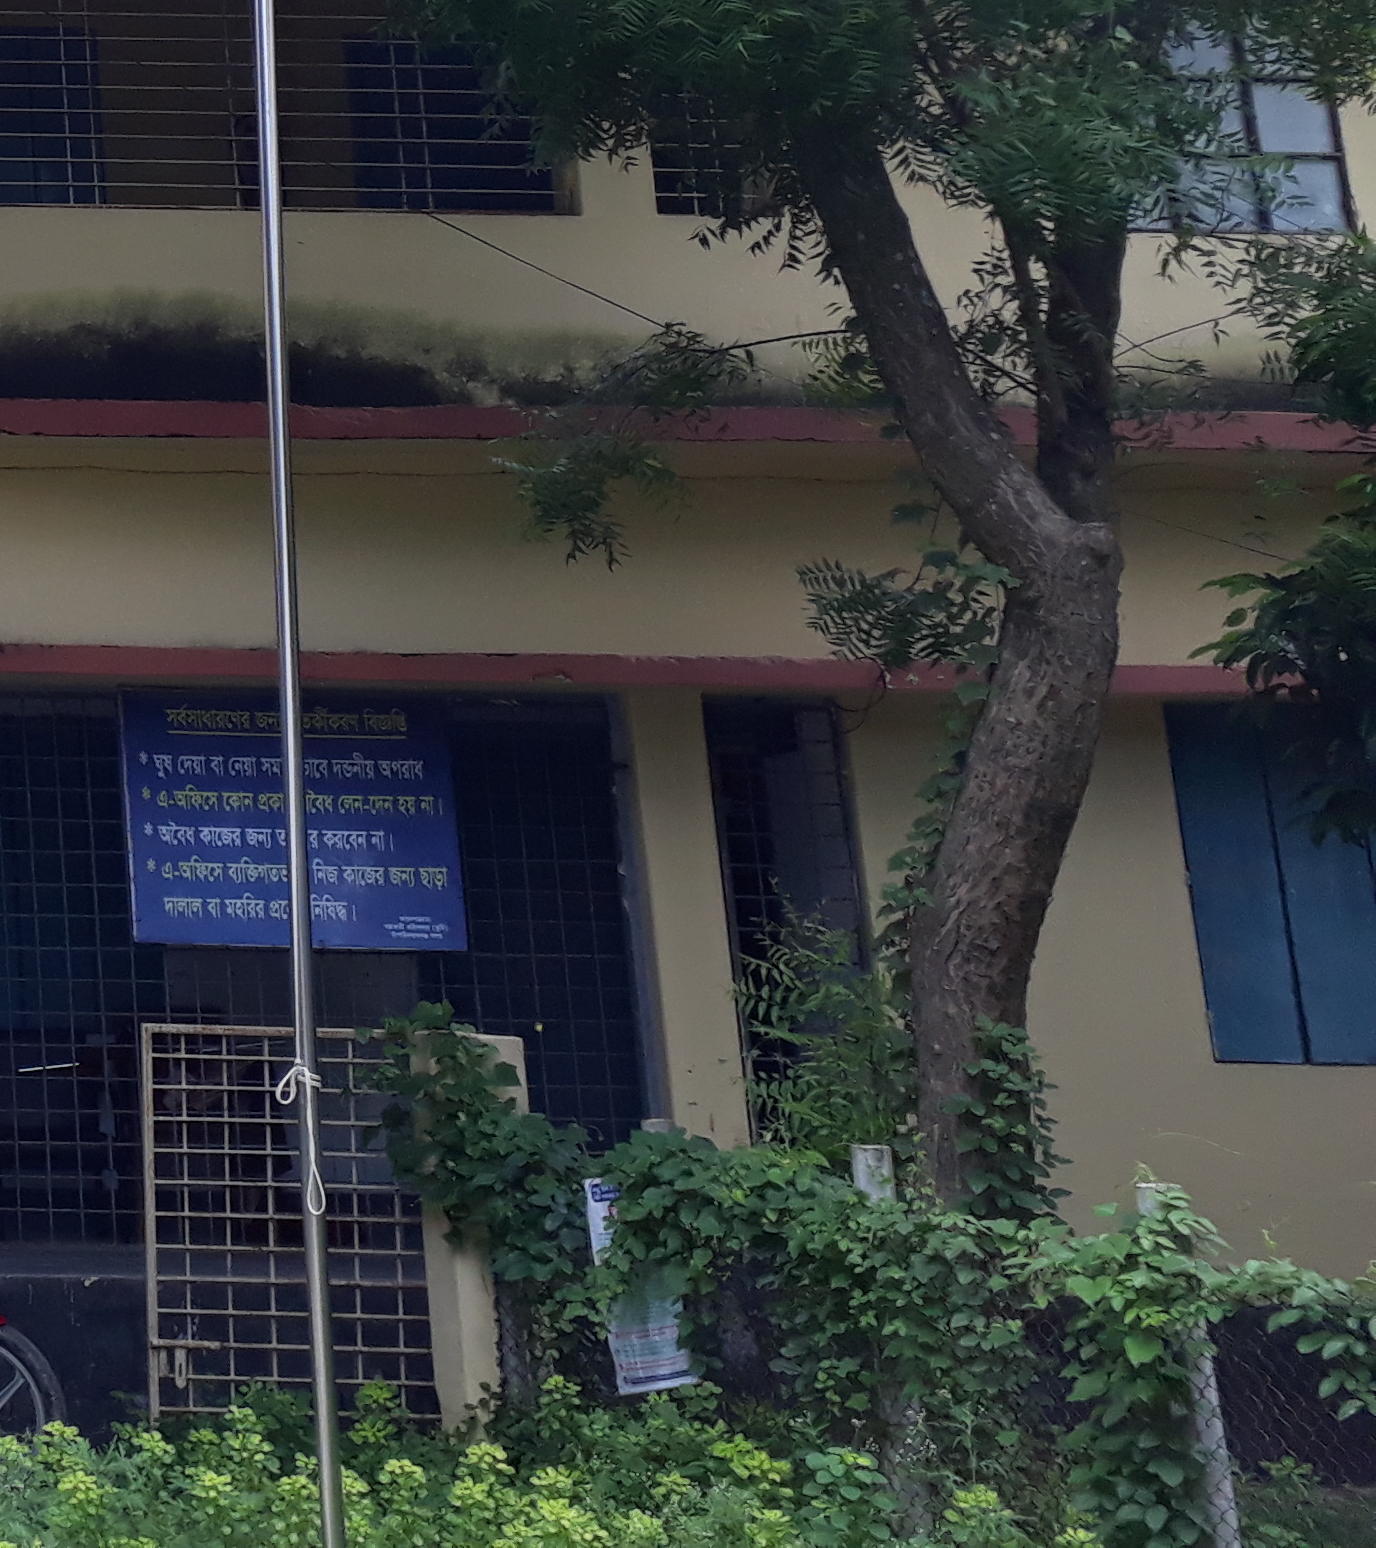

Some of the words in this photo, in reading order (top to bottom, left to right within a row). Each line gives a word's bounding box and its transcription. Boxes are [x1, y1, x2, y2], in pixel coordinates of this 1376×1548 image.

[152, 753, 174, 779] ঘুষ
[209, 755, 225, 777] বা
[378, 759, 424, 780] অপরাধ
[221, 791, 255, 812] কোন
[257, 792, 285, 814] প্রকা
[156, 820, 196, 847] অবৈধ
[198, 825, 243, 848] কাজের
[245, 828, 273, 850] জন্য
[321, 830, 368, 851] করবেন
[312, 856, 339, 886] নিজ
[341, 865, 386, 887] কাজের
[387, 866, 416, 888] জন্য
[163, 896, 204, 918] দালাল
[206, 897, 222, 919] বা
